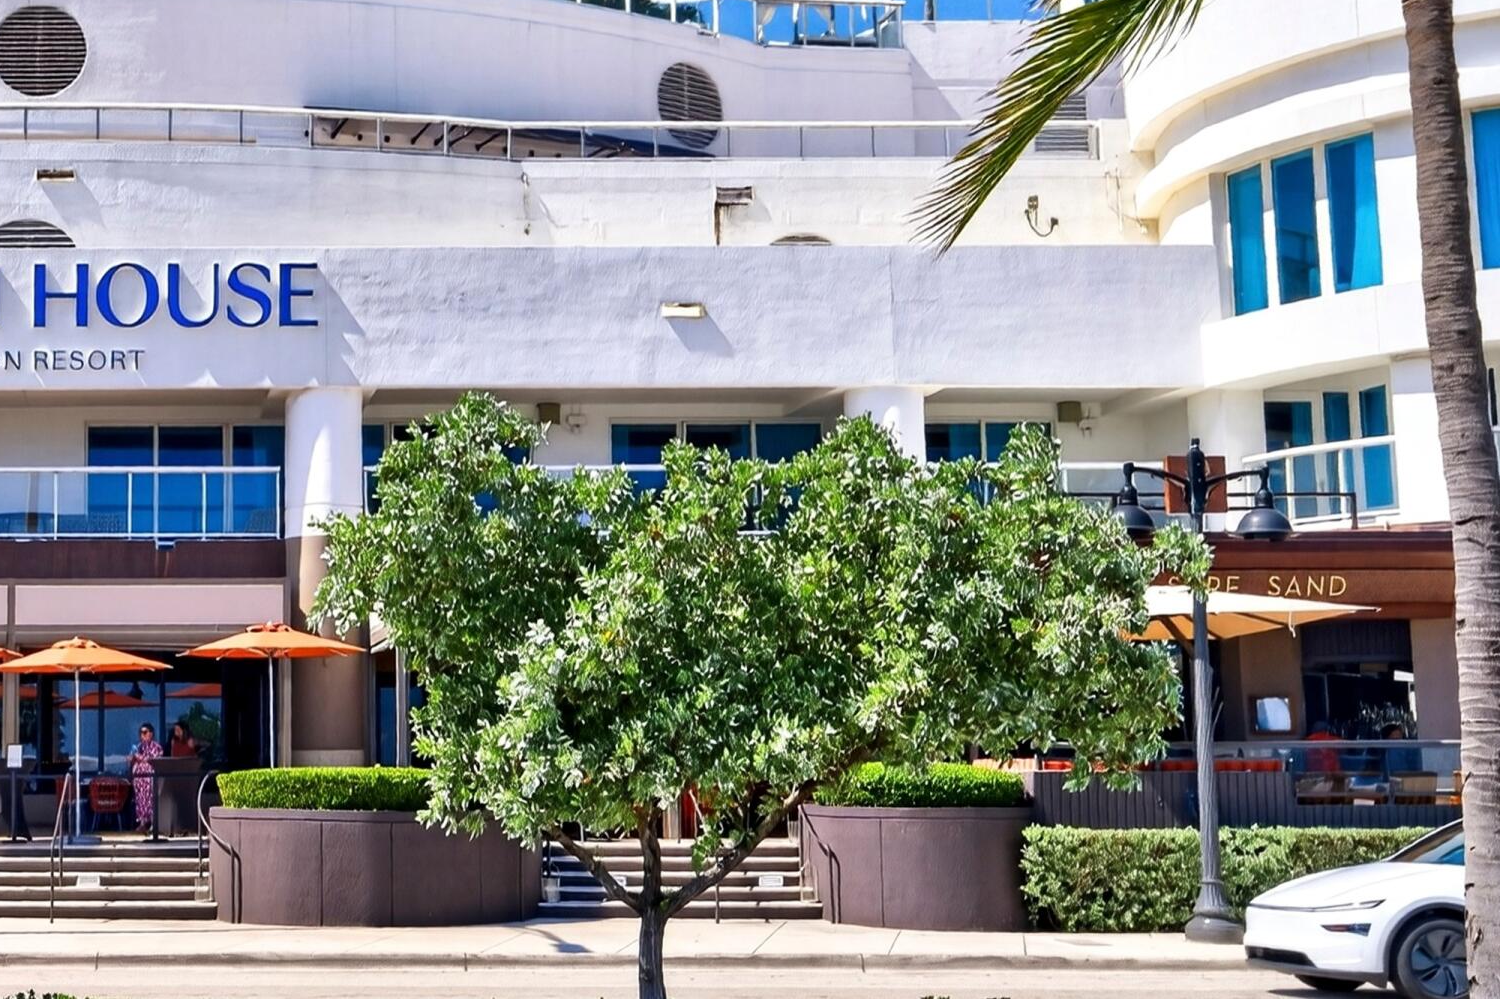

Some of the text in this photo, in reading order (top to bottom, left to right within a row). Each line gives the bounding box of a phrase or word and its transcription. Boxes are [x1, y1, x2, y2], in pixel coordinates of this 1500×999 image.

[33, 263, 318, 328] HOUSE
[35, 350, 145, 371] RESORT
[1268, 575, 1346, 596] SAND
